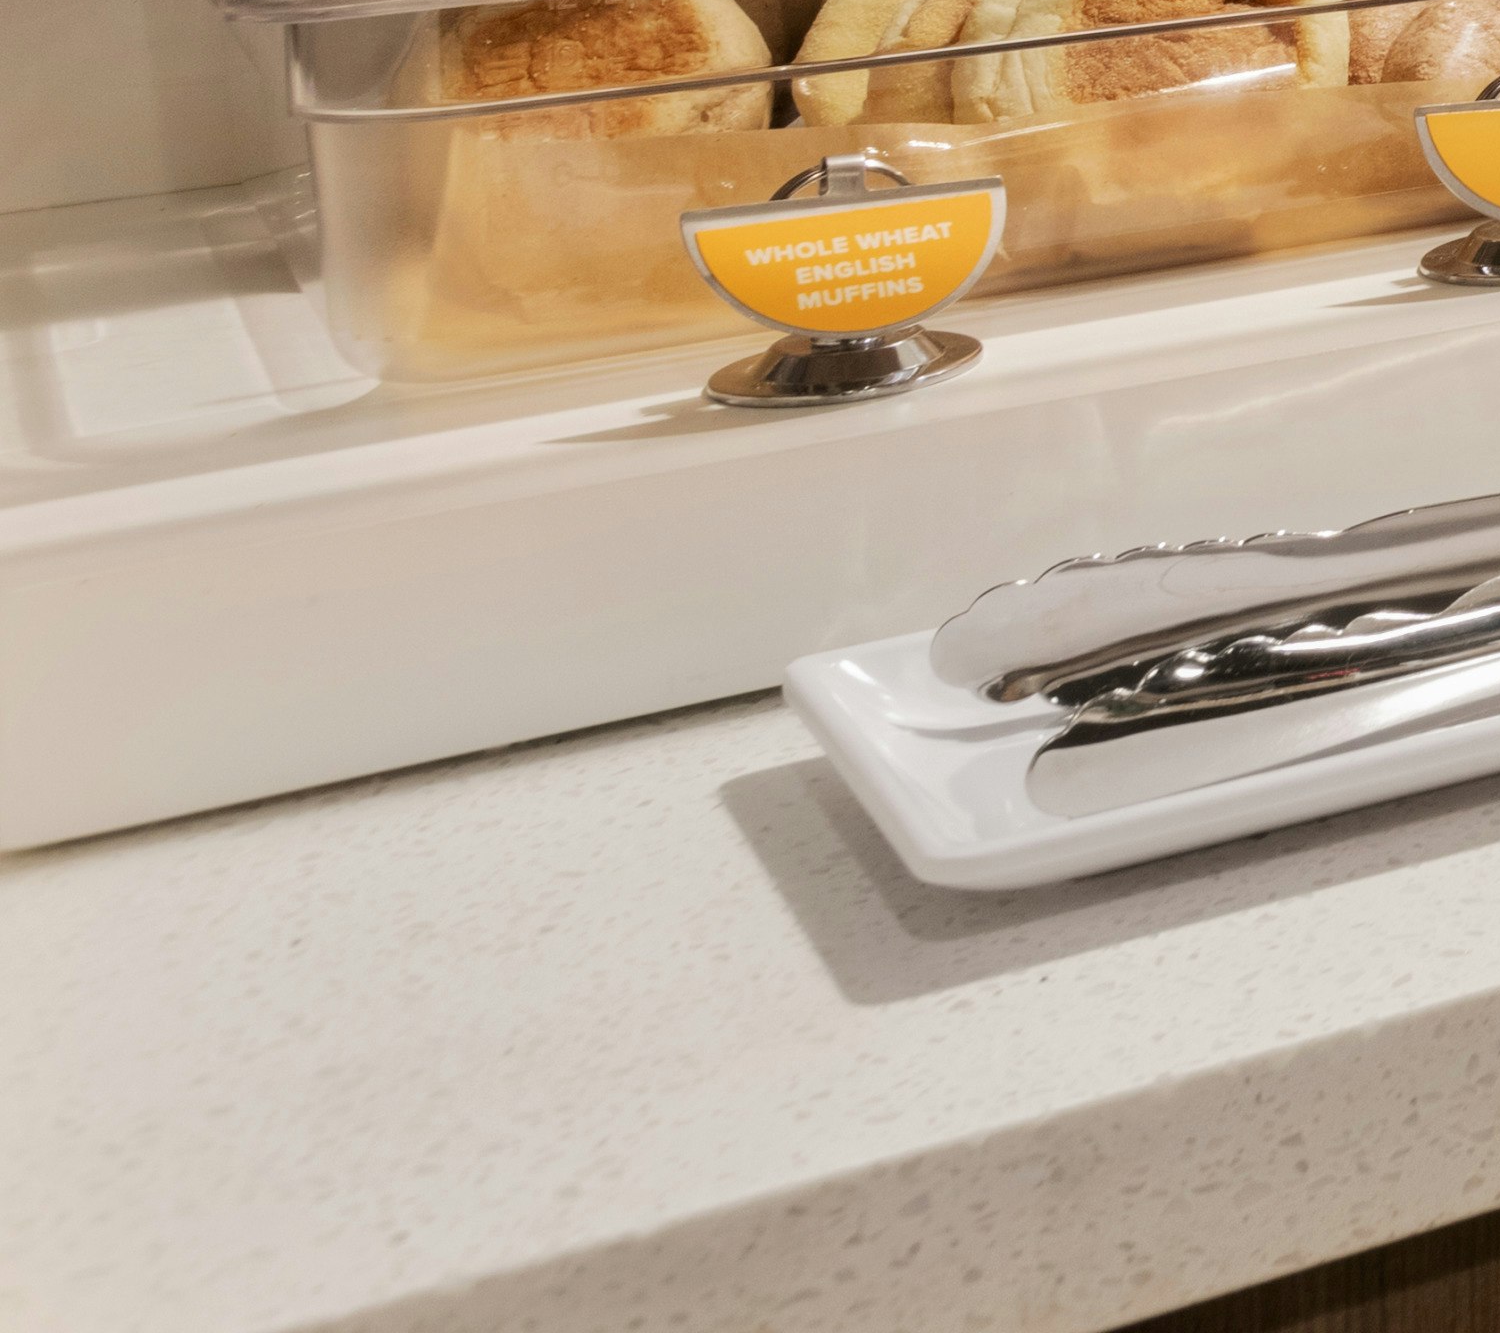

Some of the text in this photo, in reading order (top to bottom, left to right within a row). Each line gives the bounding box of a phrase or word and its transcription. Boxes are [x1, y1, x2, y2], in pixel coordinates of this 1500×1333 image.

[745, 221, 953, 266] WHOLE WHEAT
[796, 252, 916, 285] ENGLISH
[798, 276, 924, 310] MUFFINS
